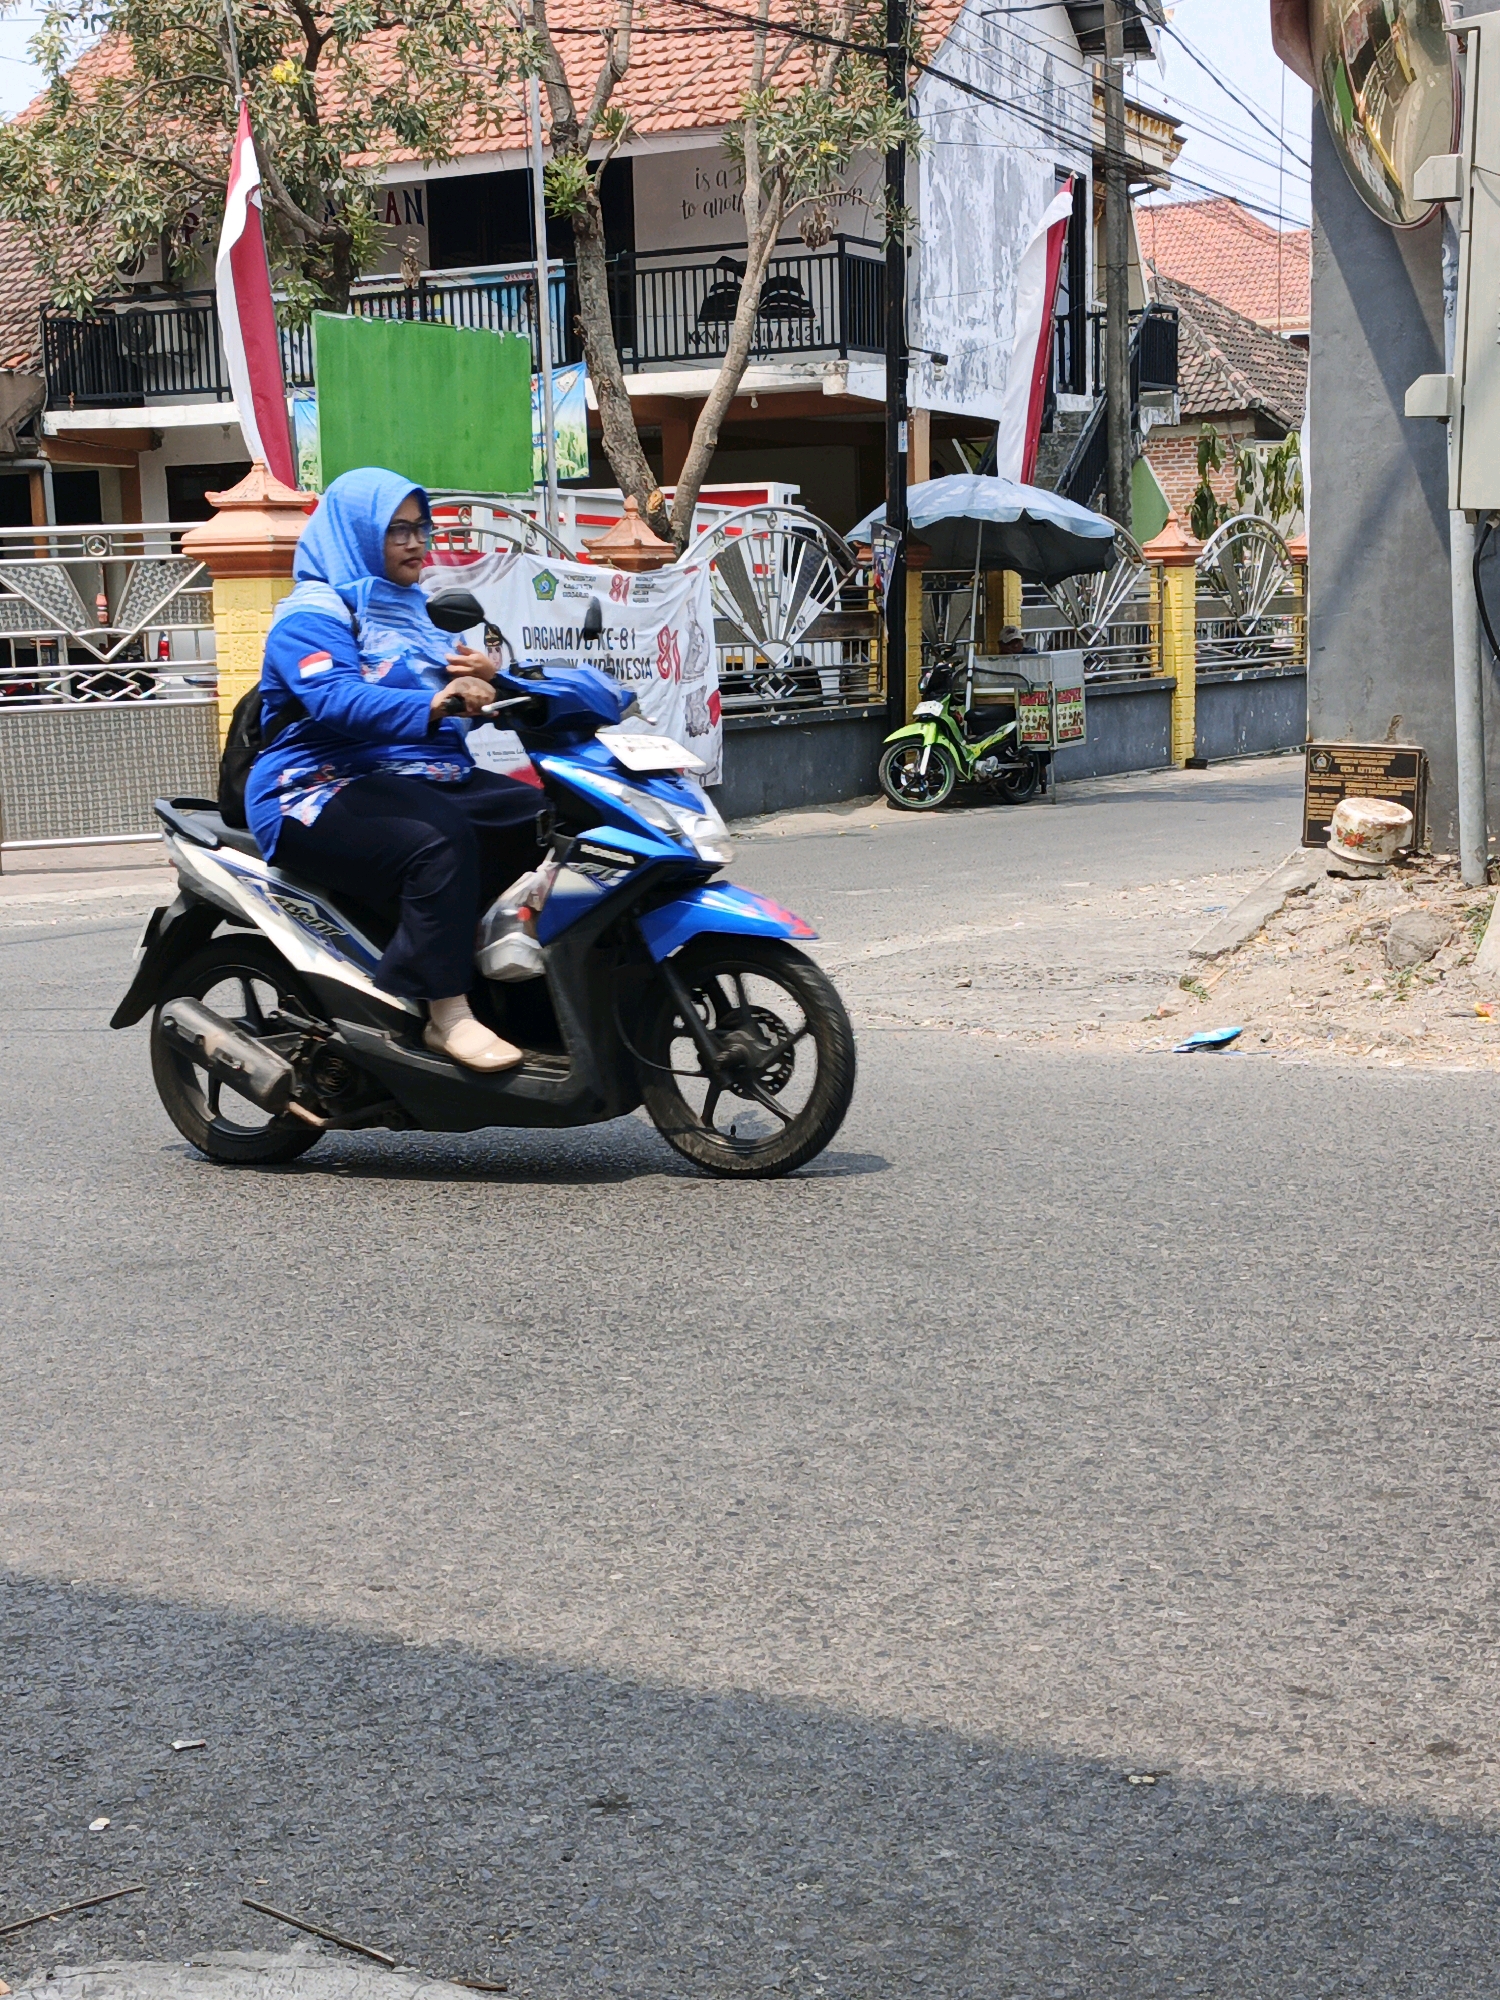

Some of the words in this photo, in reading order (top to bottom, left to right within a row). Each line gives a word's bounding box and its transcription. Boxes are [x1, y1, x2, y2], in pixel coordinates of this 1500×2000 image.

[695, 167, 711, 192] is
[716, 169, 728, 190] a
[682, 199, 697, 220] to
[609, 573, 631, 606] 81
